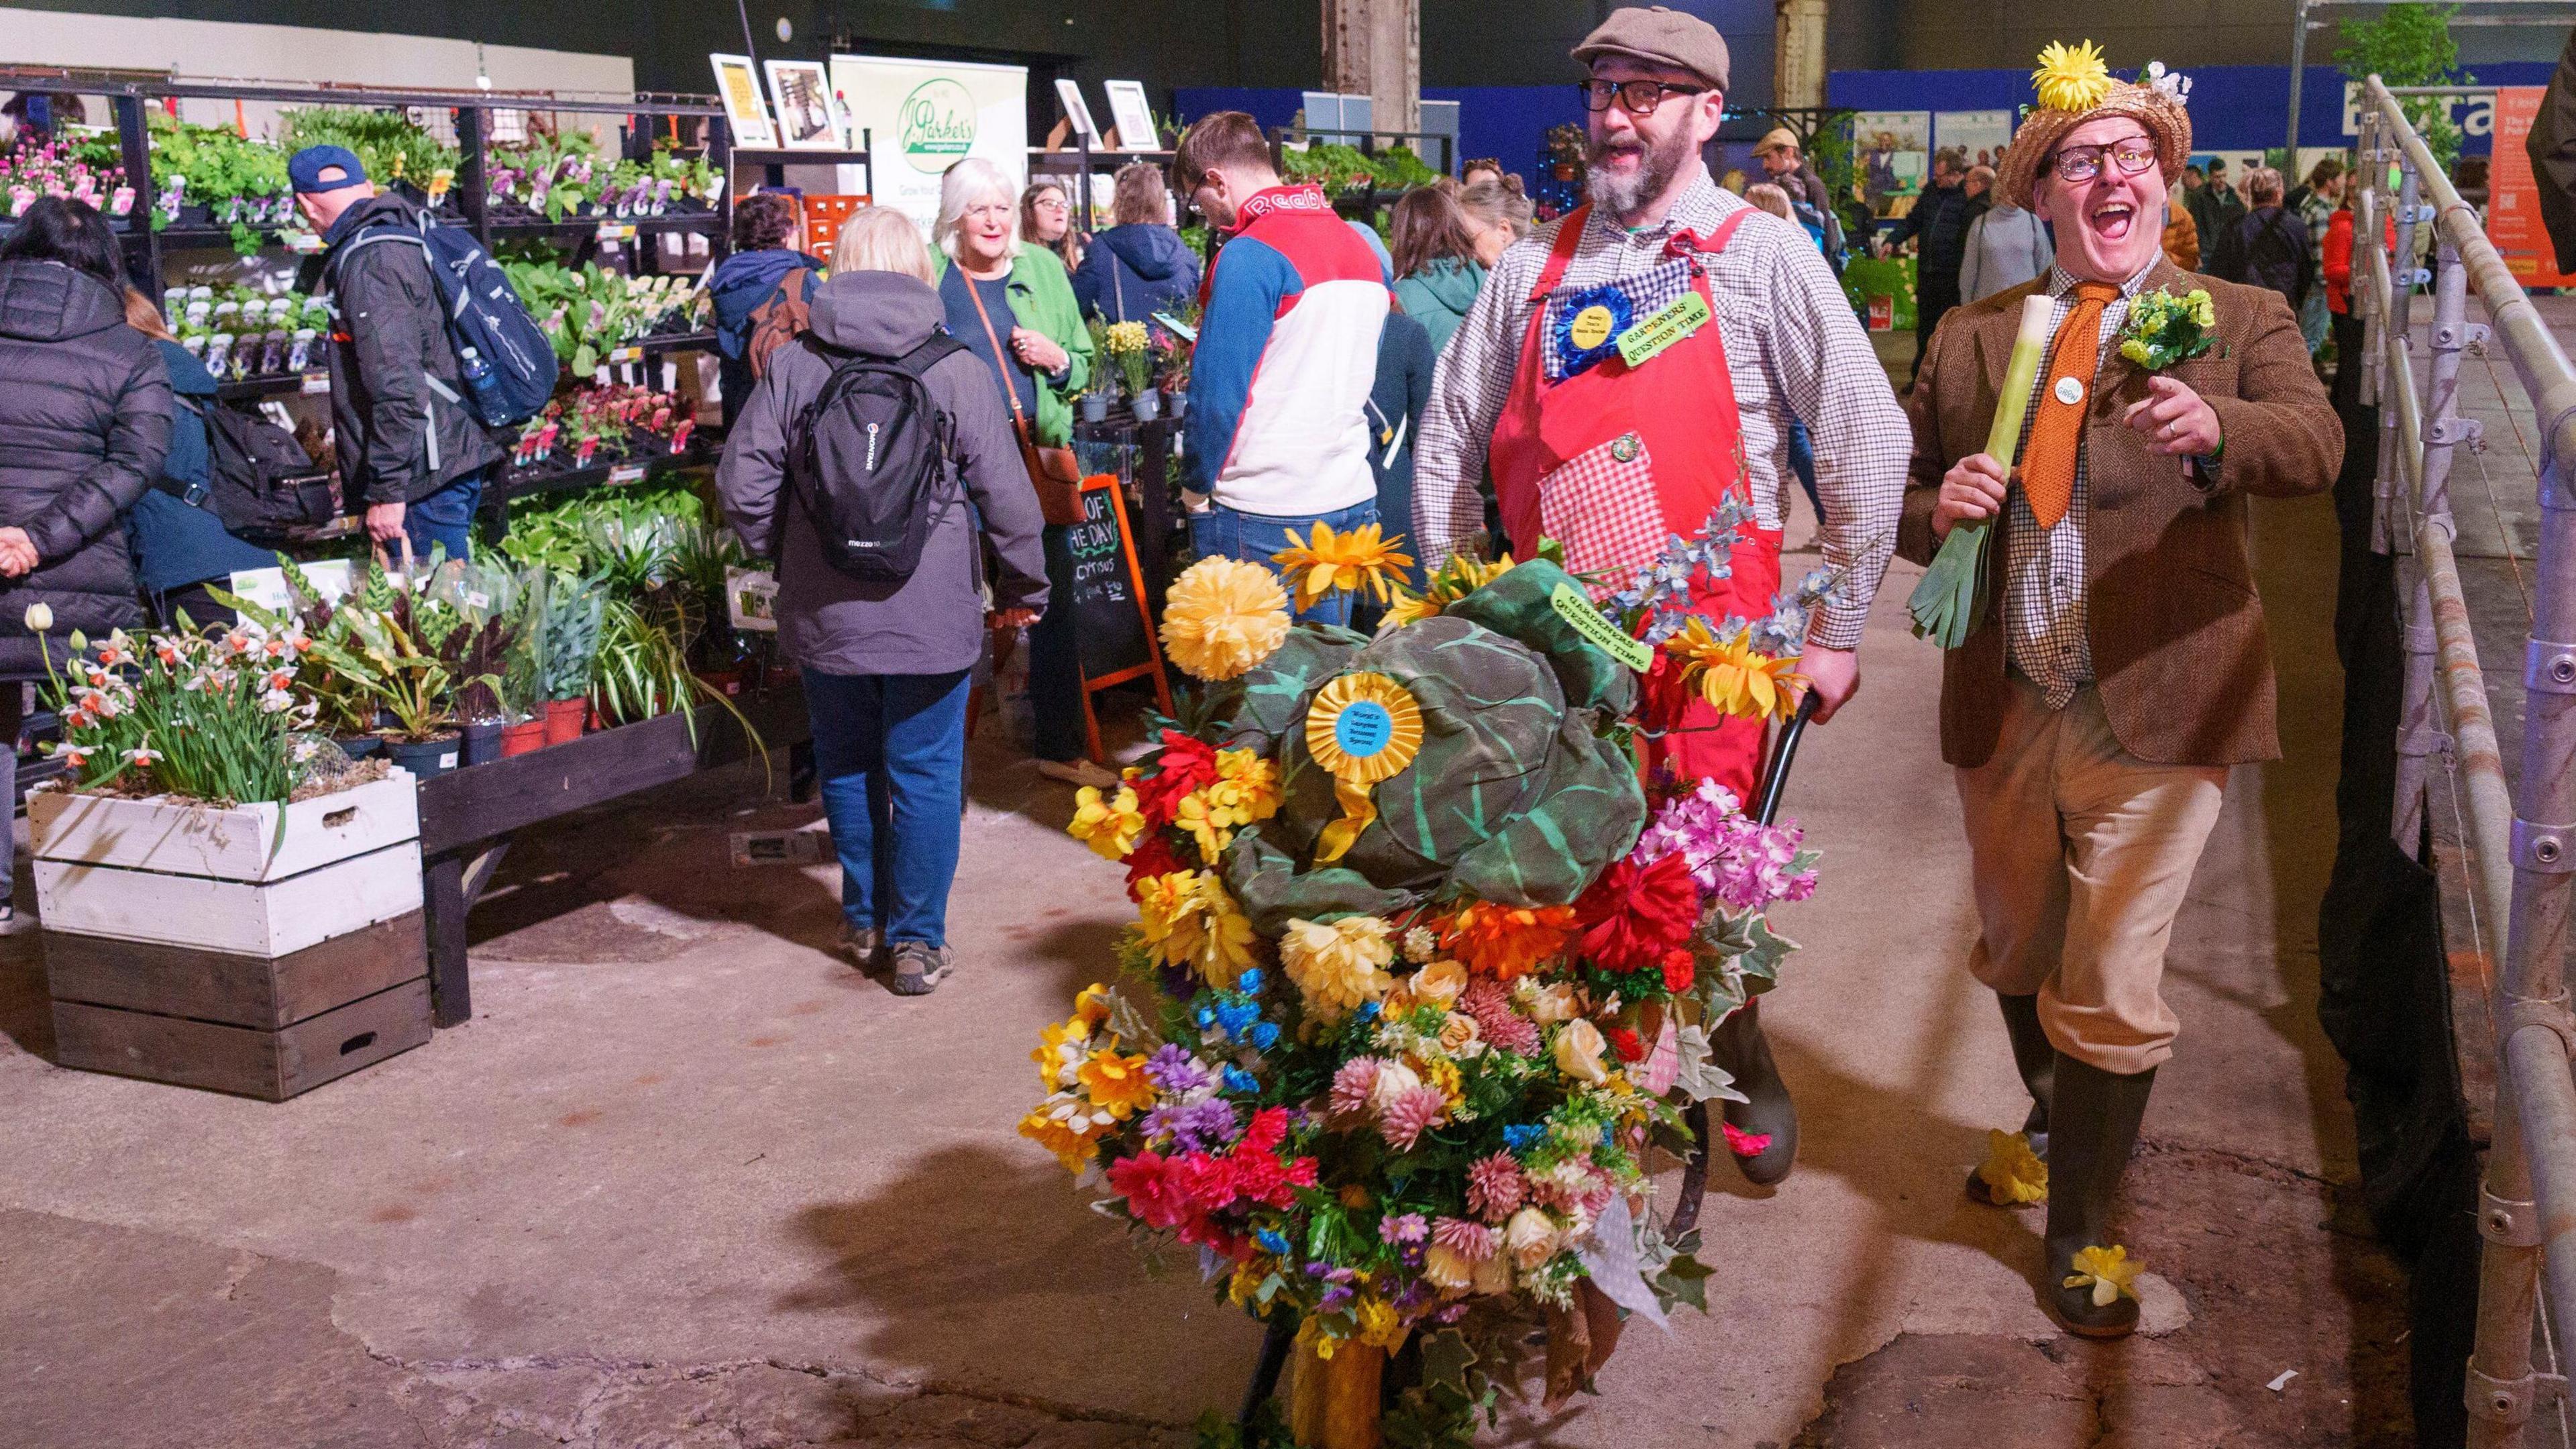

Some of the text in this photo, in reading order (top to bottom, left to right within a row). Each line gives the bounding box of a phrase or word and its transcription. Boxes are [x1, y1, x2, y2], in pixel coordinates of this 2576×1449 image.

[1628, 309, 1707, 362] QUESTION TIME
[866, 433, 875, 470] MONTANE
[1084, 496, 1106, 520] OF
[1088, 521, 1114, 547] DAY
[1076, 557, 1115, 580] CYTISUS
[1556, 599, 1644, 667] QUESTION TIME
